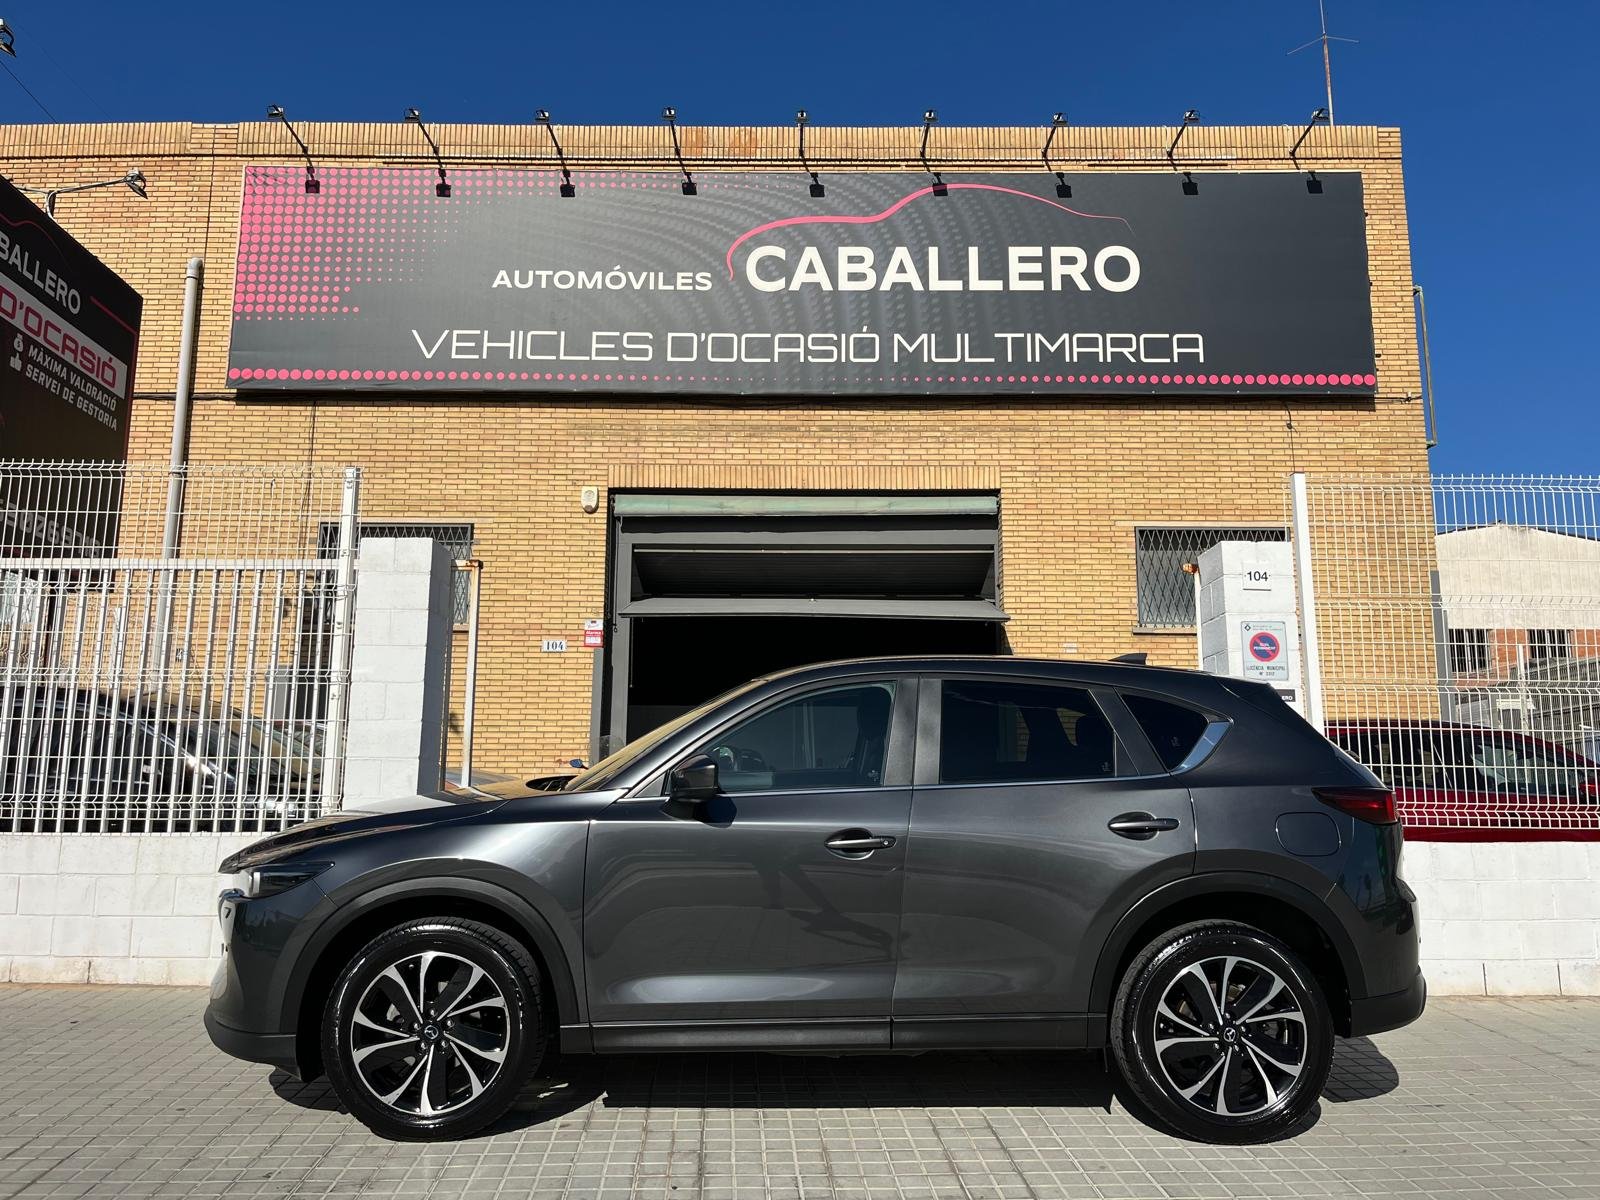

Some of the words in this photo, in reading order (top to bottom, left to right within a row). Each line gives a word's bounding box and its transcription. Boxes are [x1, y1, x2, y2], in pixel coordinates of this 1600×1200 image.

[491, 264, 713, 292] AUTOMÓVILES
[745, 245, 1141, 293] CABALLERO
[411, 329, 654, 363] VEHICLES
[665, 325, 880, 363] D'OCASIÓ
[25, 364, 61, 395] SERVEI
[62, 387, 76, 405] DE
[76, 396, 118, 431] GESTORIA
[69, 371, 117, 412] VALORACIÓ
[1246, 570, 1269, 582] 104
[546, 641, 564, 650] 104
